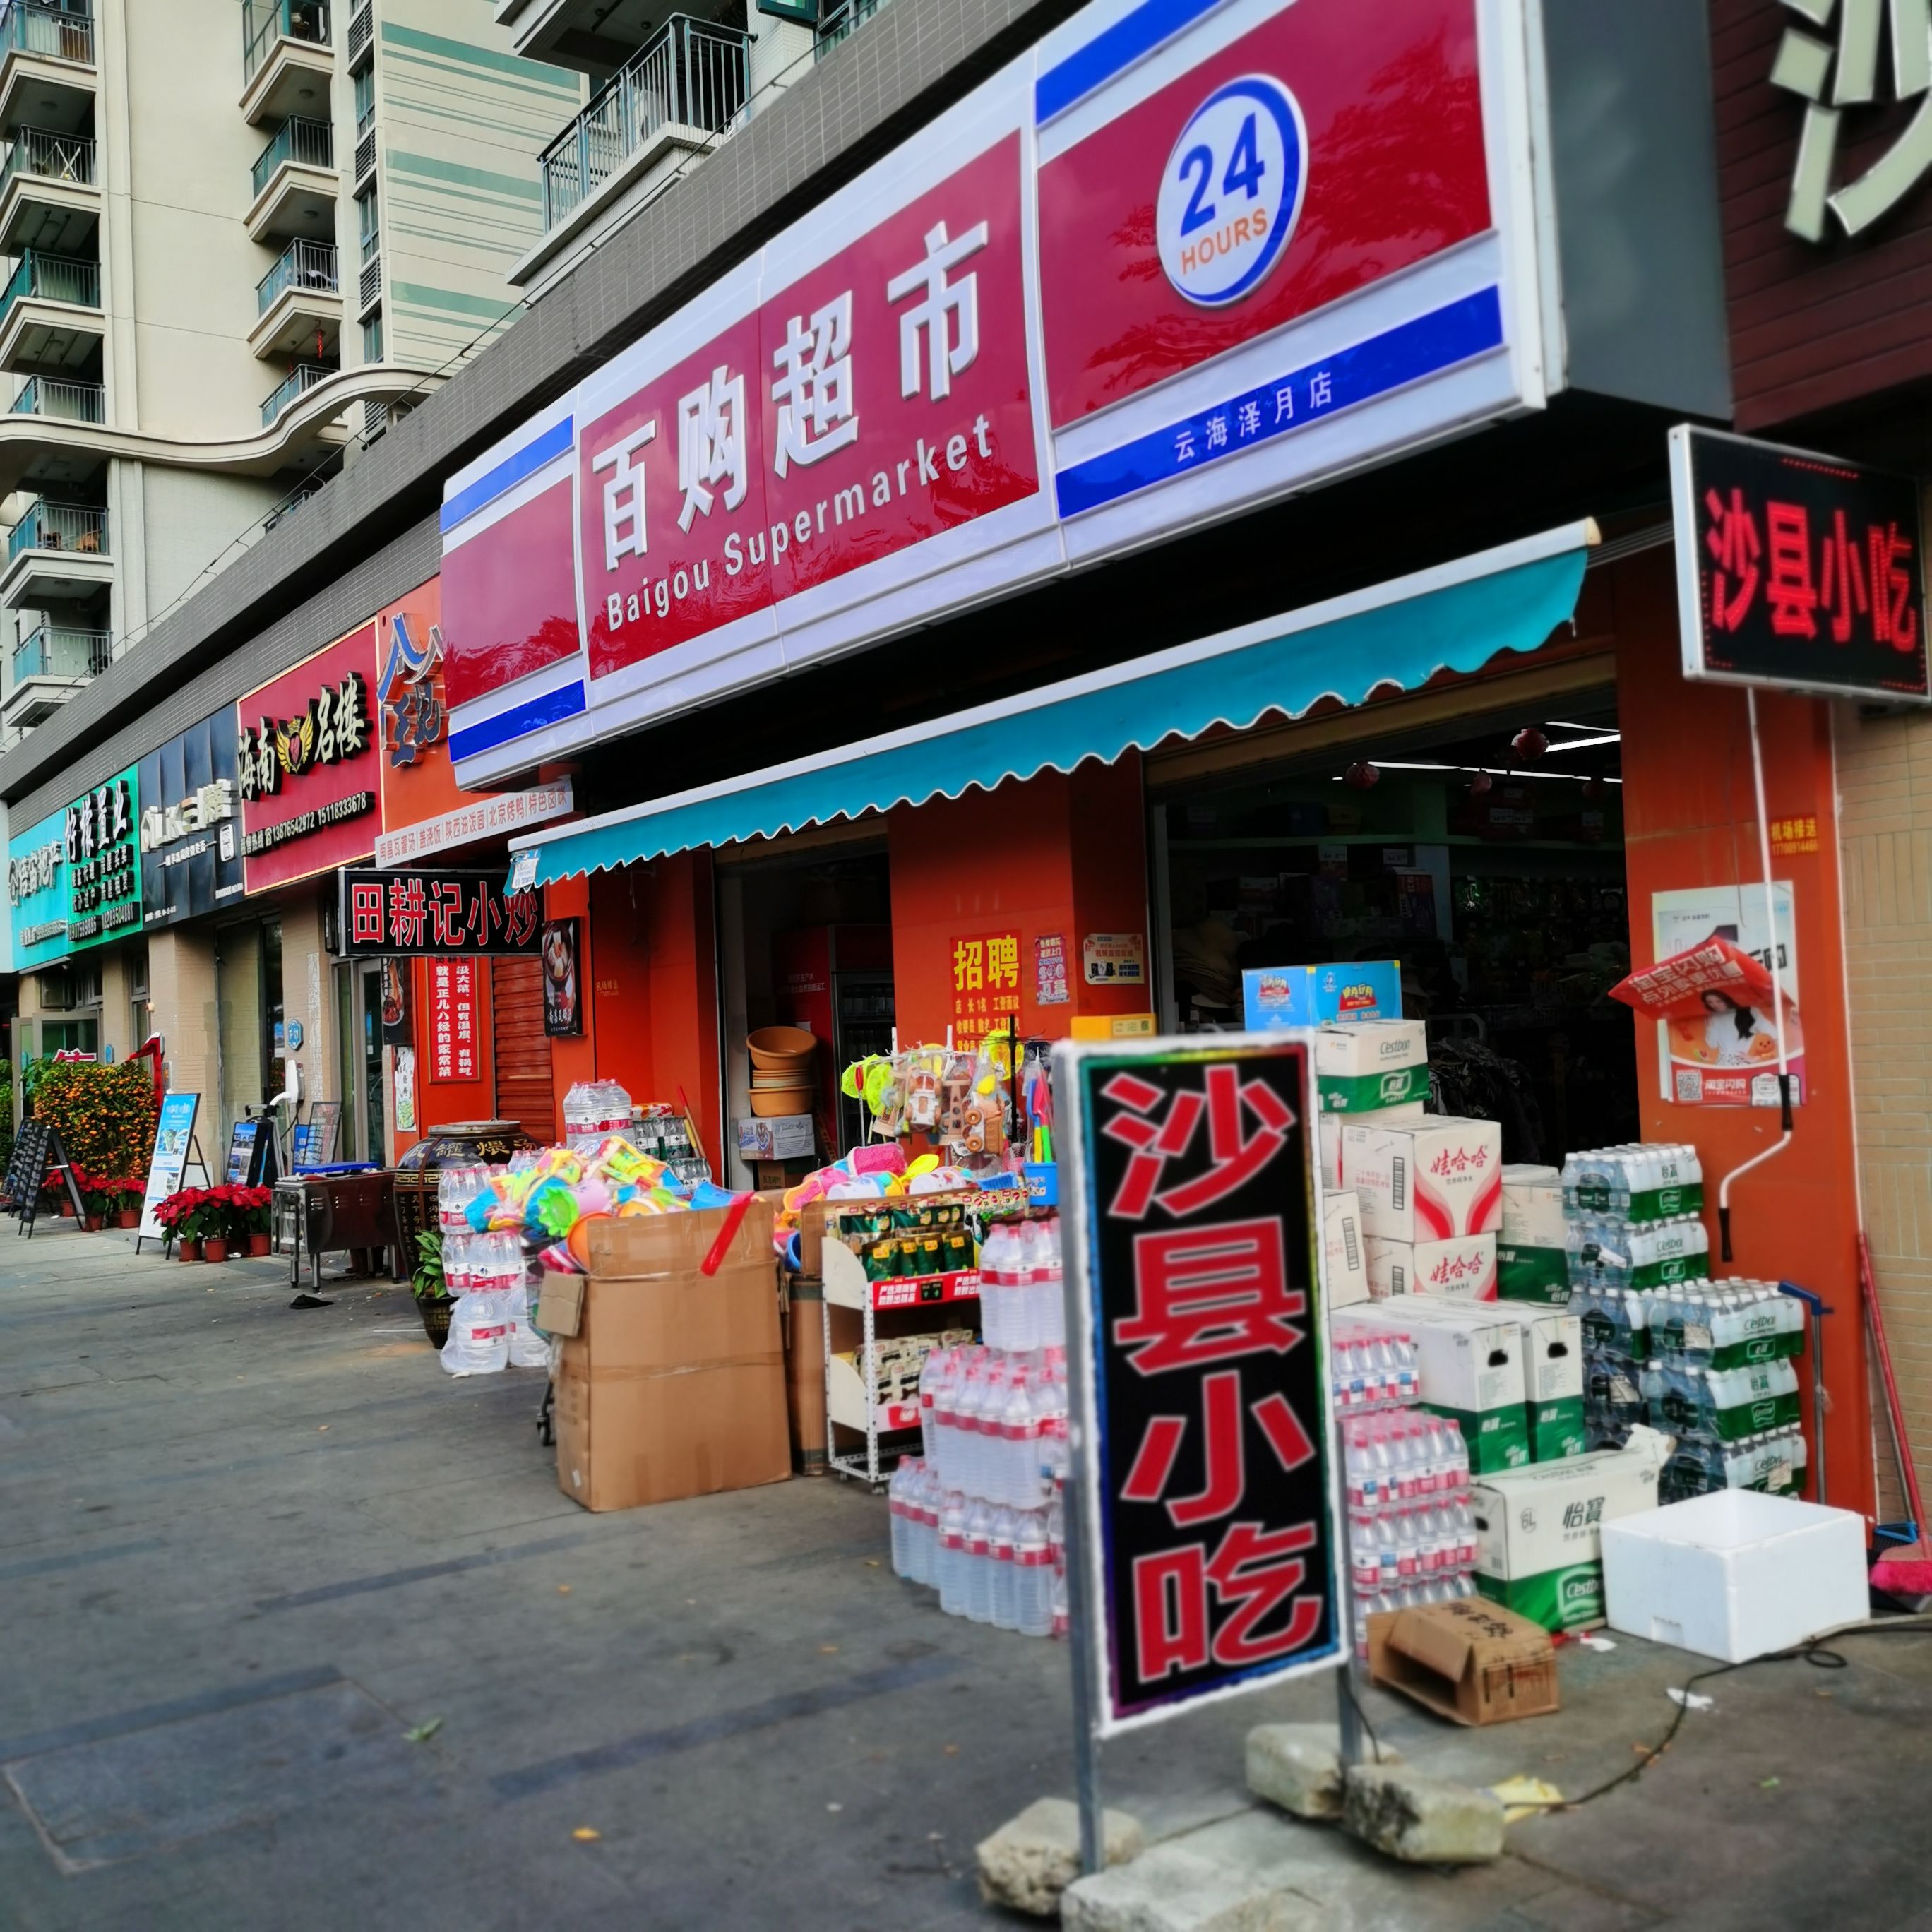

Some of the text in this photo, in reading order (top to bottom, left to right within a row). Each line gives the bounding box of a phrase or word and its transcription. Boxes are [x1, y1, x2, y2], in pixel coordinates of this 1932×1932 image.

[1178, 112, 1266, 239] 24
[1181, 208, 1268, 275] HOURS
[592, 220, 989, 573] 百购超市
[1174, 371, 1333, 463] 云海泽月店
[607, 412, 993, 632] Baigou Supermarket
[1705, 487, 1916, 651] 沙县小吃
[318, 791, 366, 825] 15118333678
[352, 878, 539, 948] 田耕记小炒
[953, 934, 1019, 991] 招聘
[1430, 1145, 1488, 1176] 娃哈哈
[1429, 1250, 1484, 1284] 娃哈哈
[1100, 1063, 1323, 1684] 沙县小吃
[1522, 1510, 1537, 1530] 6L
[1562, 1496, 1606, 1530] 怡寶
